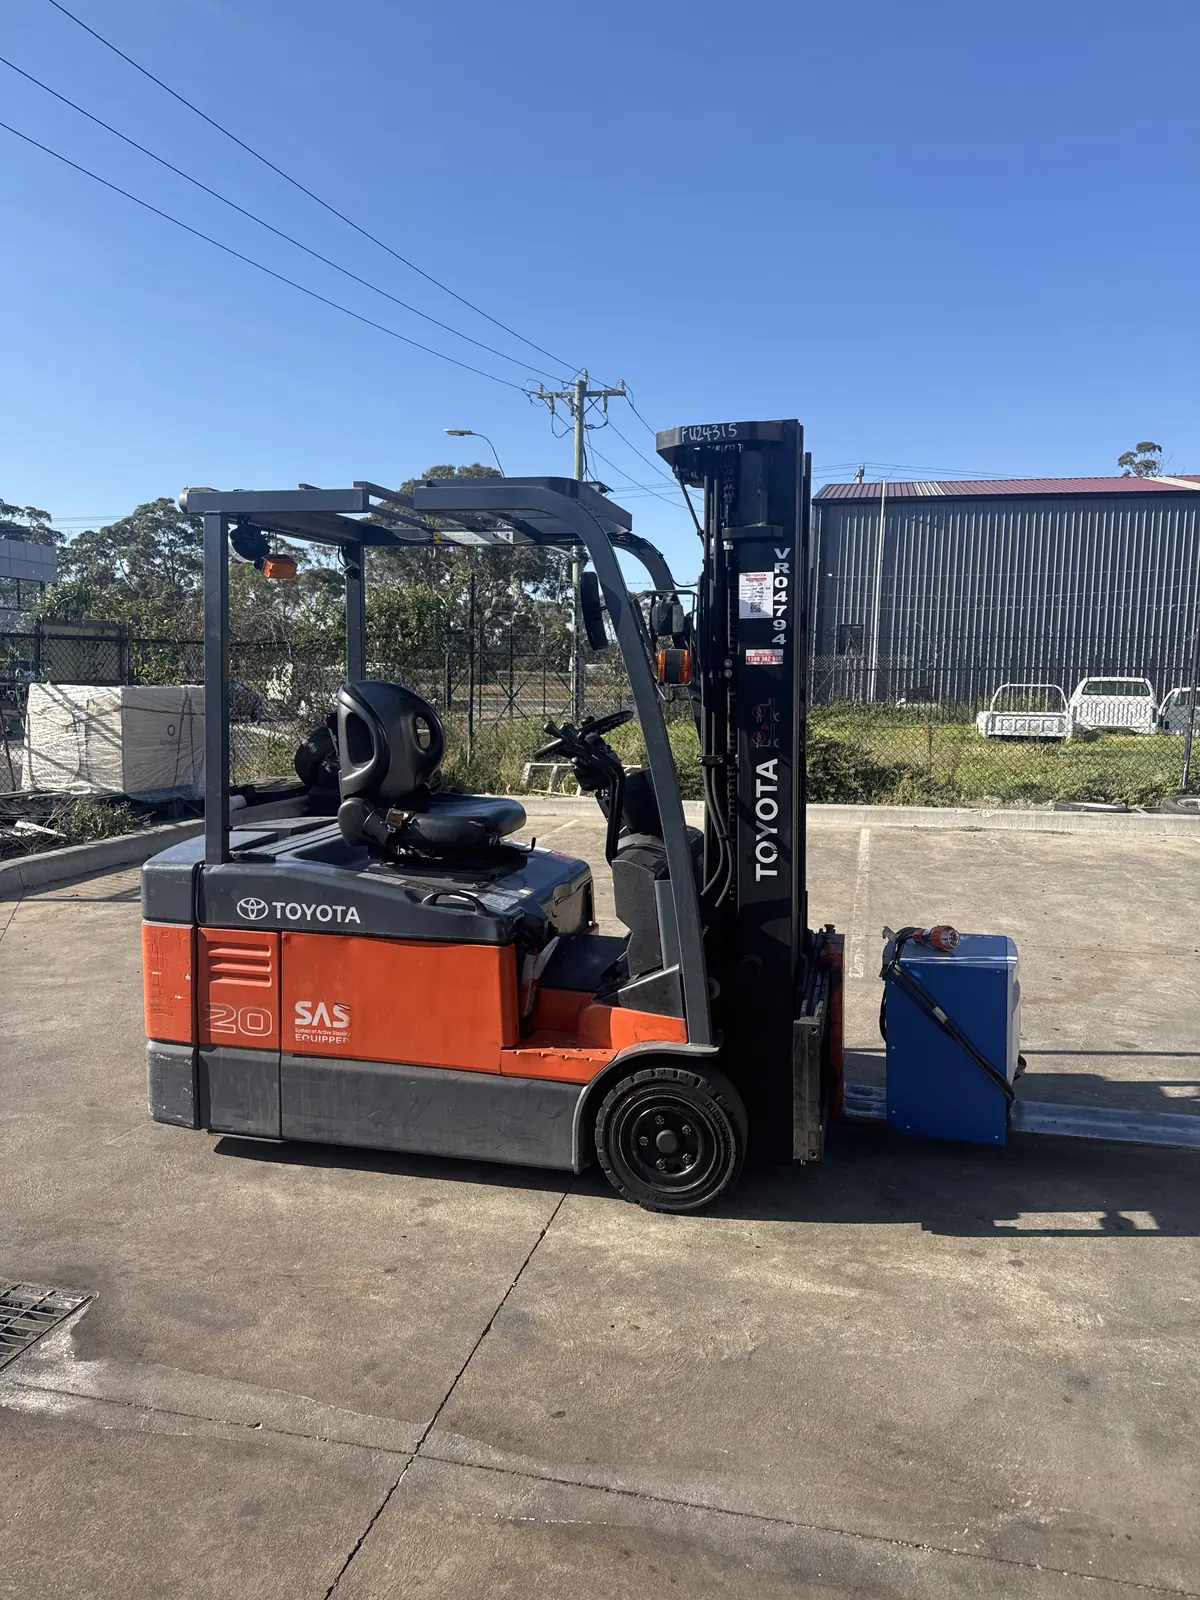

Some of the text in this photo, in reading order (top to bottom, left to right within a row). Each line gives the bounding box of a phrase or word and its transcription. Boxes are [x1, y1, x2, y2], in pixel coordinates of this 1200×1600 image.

[681, 423, 738, 443] FU24315
[772, 548, 791, 645] VR04794
[755, 758, 779, 882] TOYOTA
[272, 901, 361, 924] TOYOTA
[204, 1002, 273, 1037] 20
[295, 1001, 350, 1028] SAS
